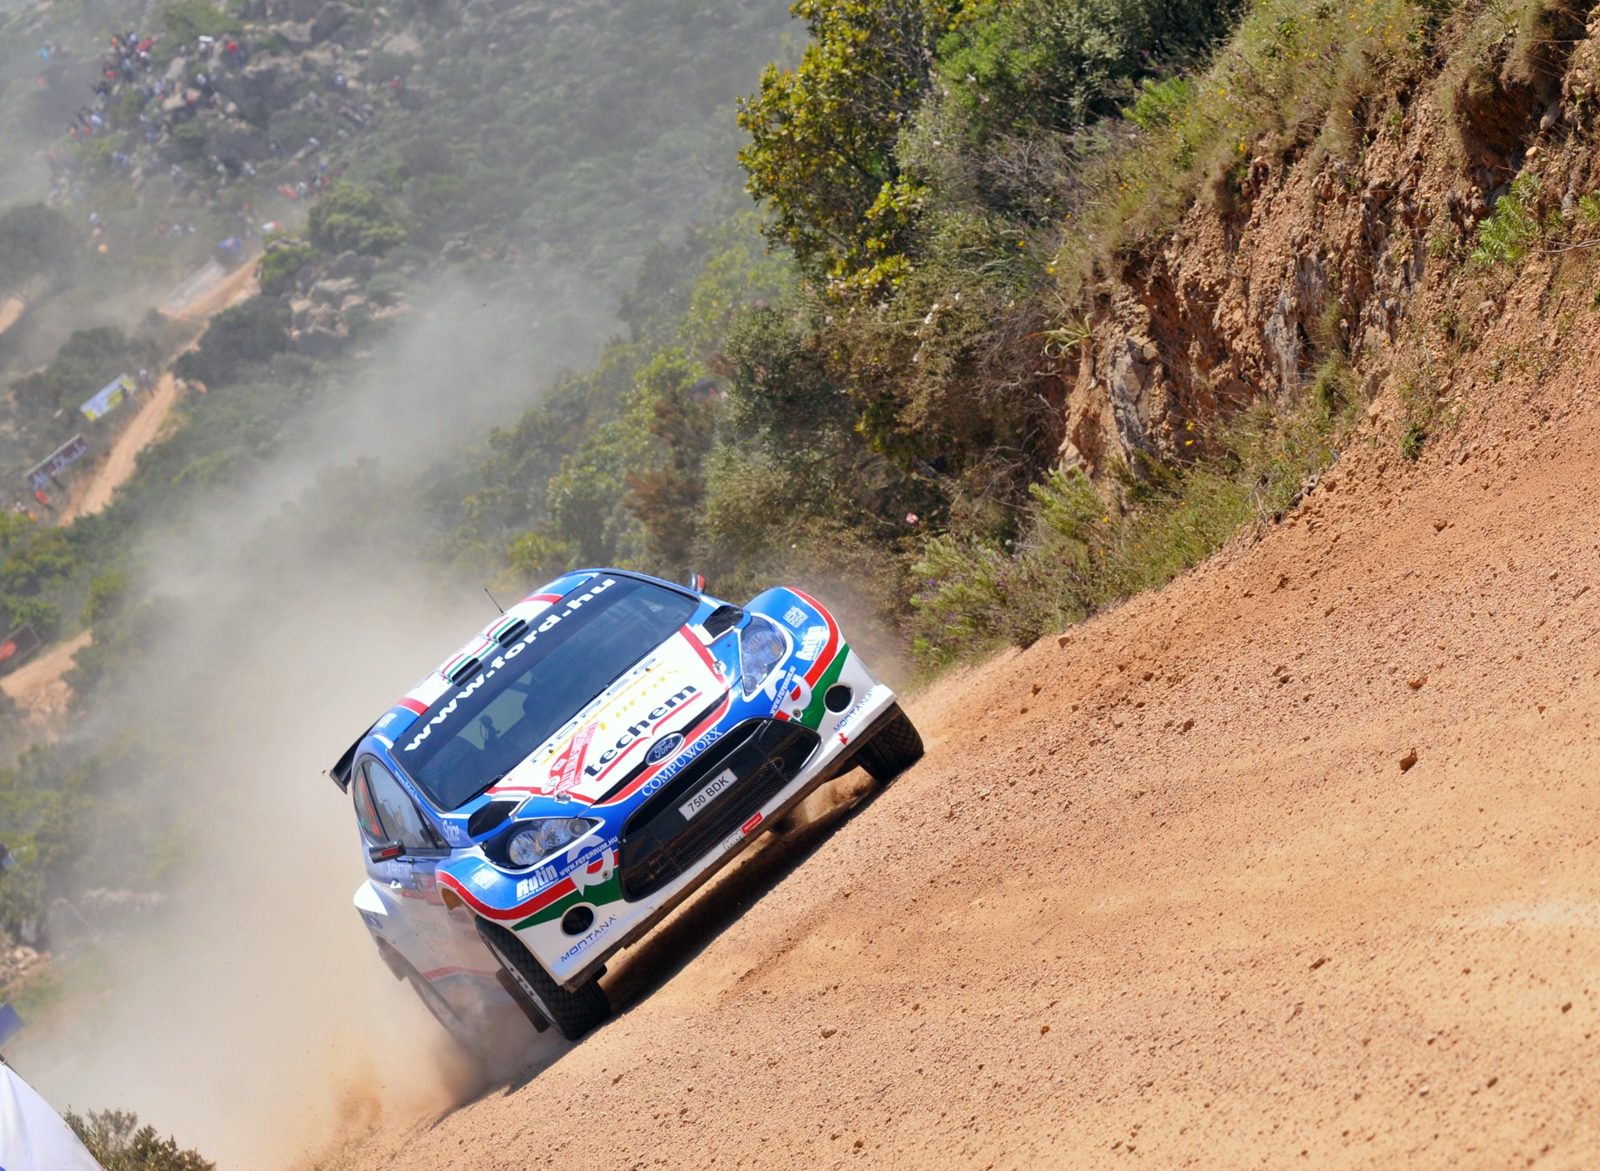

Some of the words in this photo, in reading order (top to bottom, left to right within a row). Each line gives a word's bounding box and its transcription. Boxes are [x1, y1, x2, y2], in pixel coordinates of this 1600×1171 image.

[404, 578, 616, 751] www.ford.hu
[583, 684, 708, 777] techem
[641, 726, 723, 797] COMPUWORX
[687, 794, 706, 813] 750
[705, 775, 730, 797] BDK
[517, 864, 559, 899] Rutin
[559, 836, 618, 877] WWW.FEFERRUM.HU
